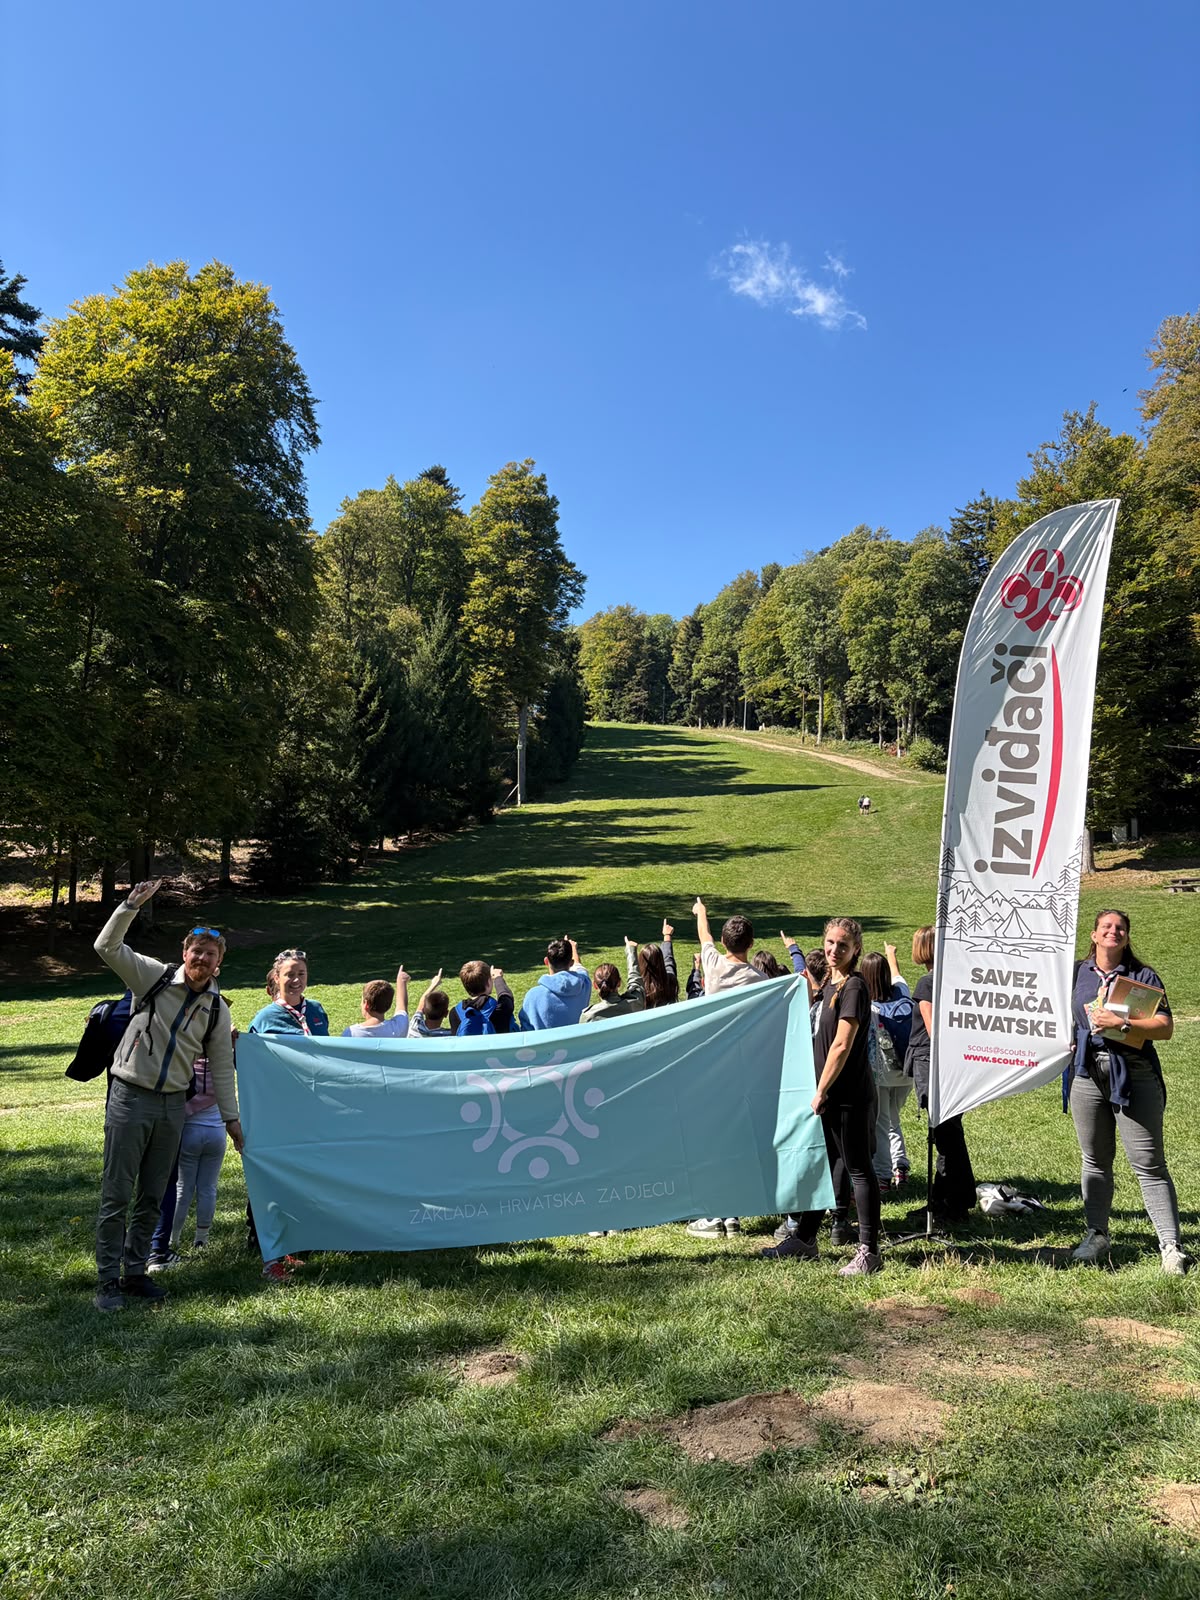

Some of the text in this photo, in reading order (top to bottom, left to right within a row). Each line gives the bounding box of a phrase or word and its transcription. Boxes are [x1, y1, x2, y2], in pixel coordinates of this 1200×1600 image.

[973, 643, 1048, 876] izviđači
[970, 967, 1038, 989] SAVEZ
[954, 988, 1054, 1014] IZVIĐAČA
[948, 1011, 1057, 1039] HRVATSKE
[963, 1053, 1040, 1068] www.scouts.hr
[967, 1043, 1037, 1058] scouts@scouts.hr
[409, 1181, 676, 1225] ZAKLADA HRVATSKA ZA DJECU
